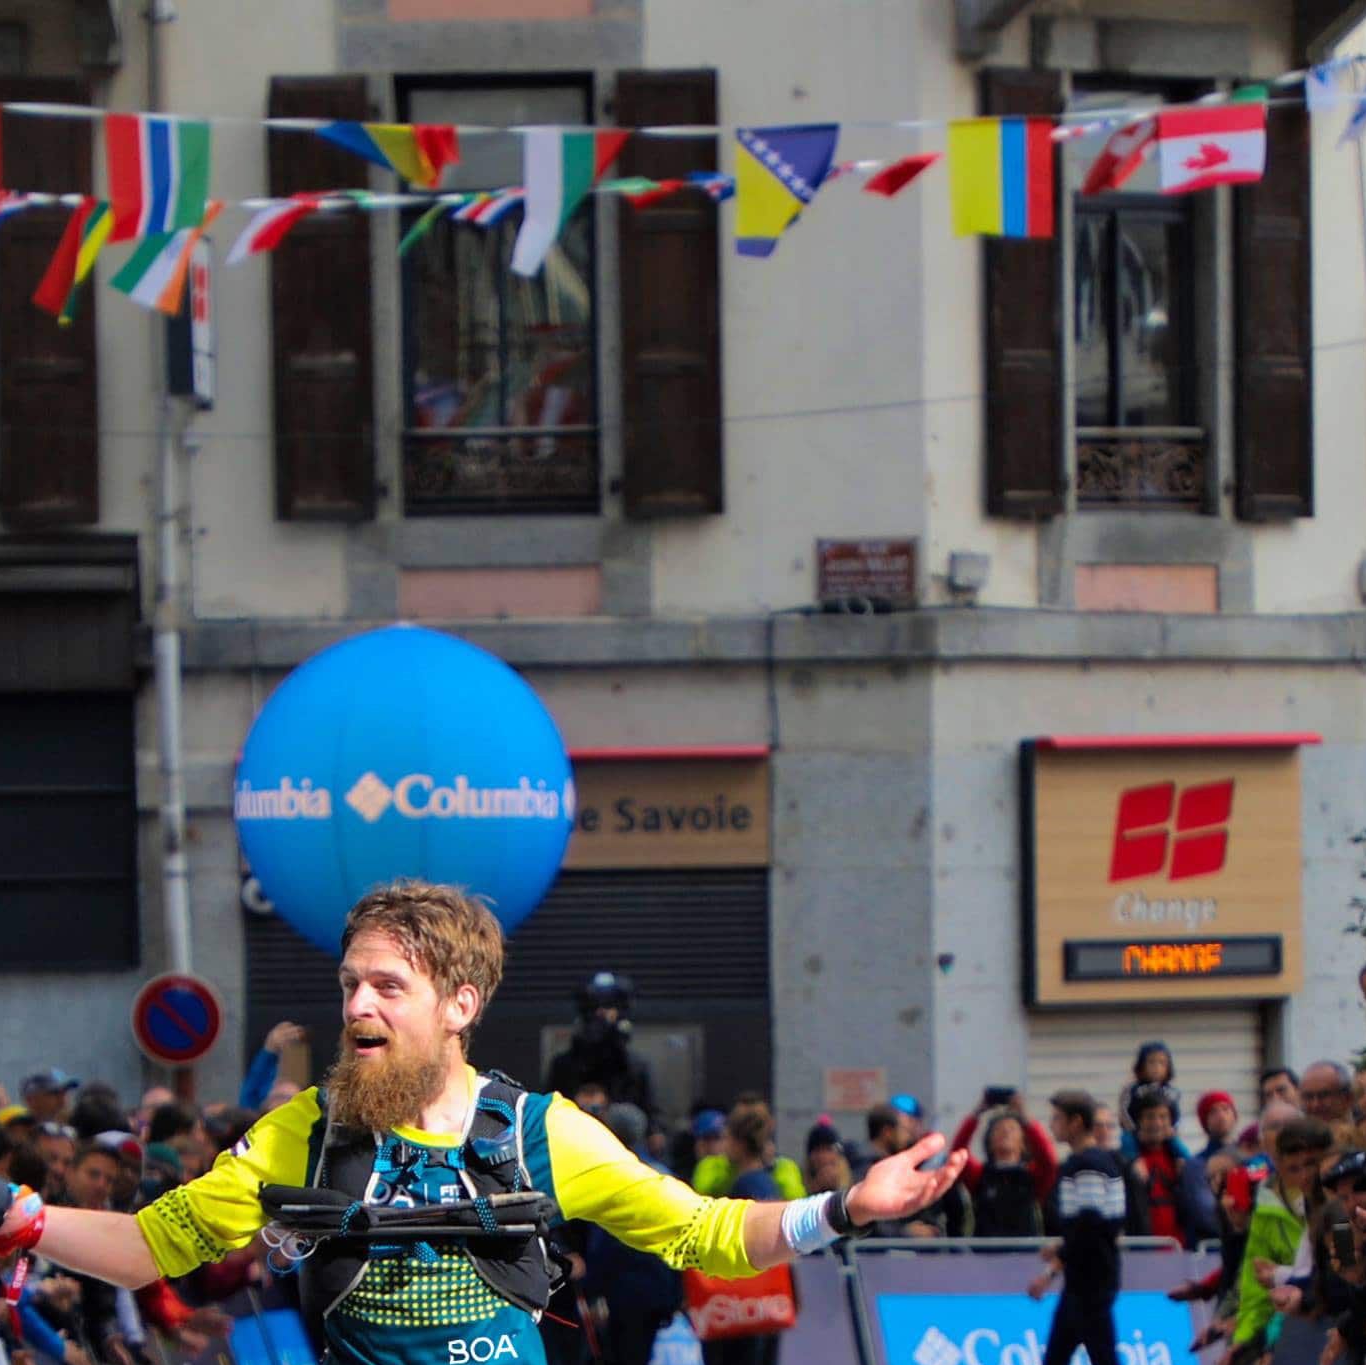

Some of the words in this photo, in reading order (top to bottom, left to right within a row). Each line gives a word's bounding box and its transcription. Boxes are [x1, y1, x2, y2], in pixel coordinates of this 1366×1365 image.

[235, 776, 332, 819] lumbia
[394, 773, 559, 819] Columbia
[613, 794, 752, 832] Savoie
[1113, 890, 1219, 932] Change
[447, 1334, 519, 1365] BOA
